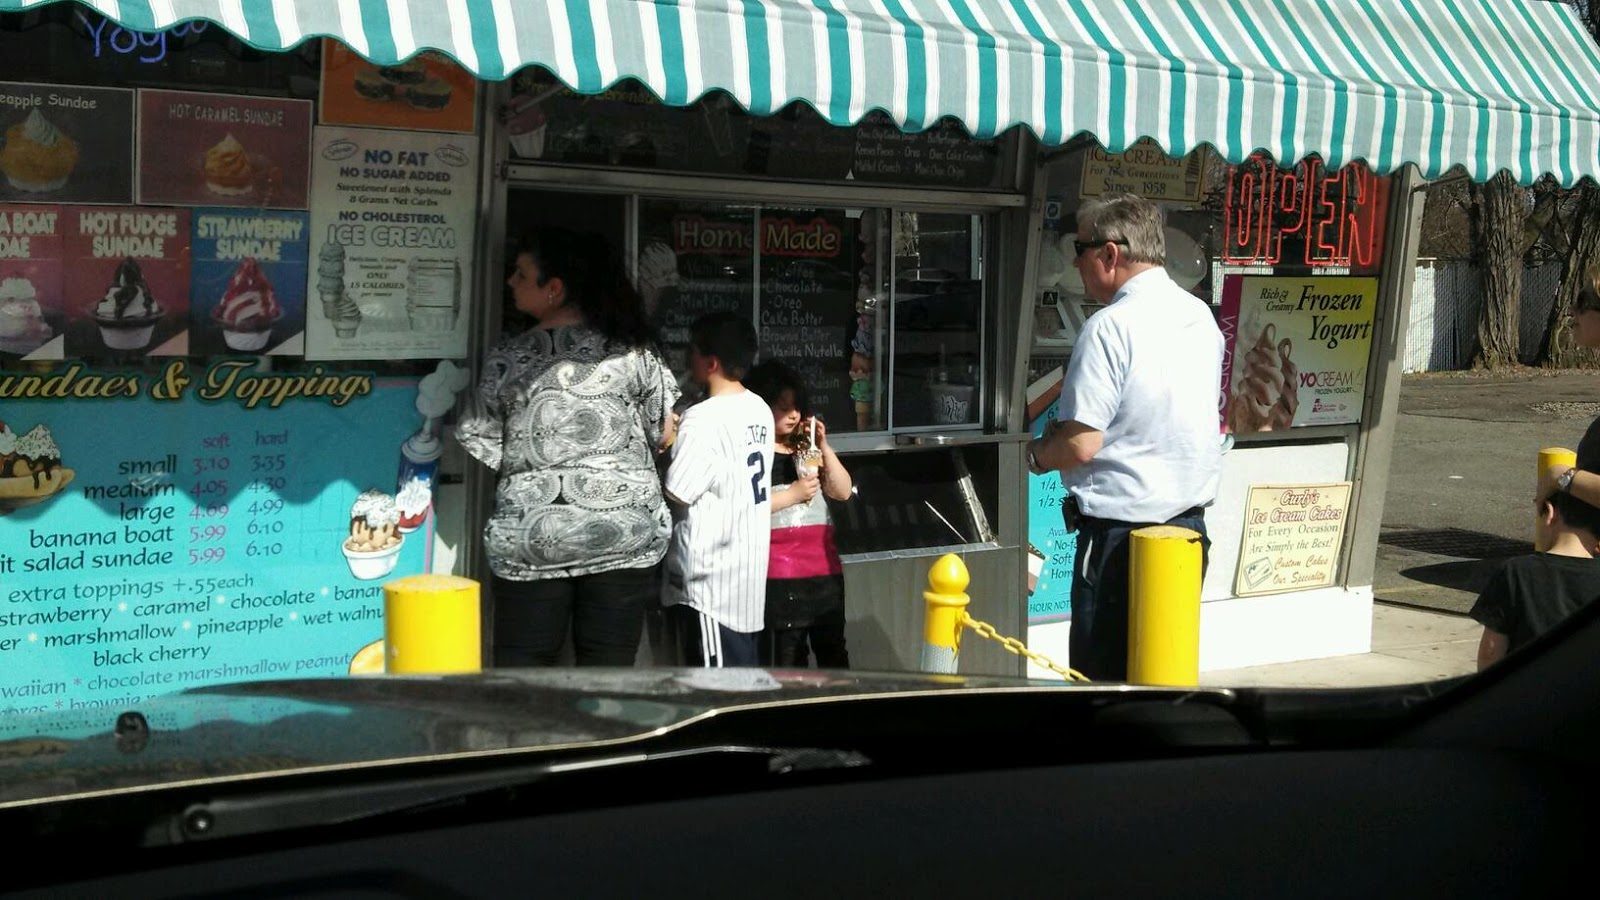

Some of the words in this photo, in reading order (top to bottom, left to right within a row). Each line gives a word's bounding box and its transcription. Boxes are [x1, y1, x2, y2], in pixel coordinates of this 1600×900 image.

[48, 94, 97, 109] Sundae
[169, 104, 191, 119] HOT
[194, 105, 242, 124] CARAMEL
[244, 110, 283, 126] SUNDAE
[364, 149, 393, 164] NO
[397, 151, 429, 166] FAT
[904, 146, 921, 158] Oreo
[339, 167, 360, 178] NO
[363, 168, 406, 180] SUGAR
[409, 171, 451, 182] ADDED
[1090, 165, 1106, 176] For
[1127, 167, 1181, 181] Generations
[336, 183, 388, 193] Sweetened
[414, 186, 452, 196] Splenda
[1103, 177, 1134, 193] Since
[1142, 181, 1167, 196] 1958
[358, 195, 390, 205] Grams
[392, 196, 408, 205] Net
[410, 197, 438, 206] Carbs
[339, 211, 359, 221] NO
[361, 212, 447, 225] CHOLESTEROL
[1221, 155, 1377, 265] OPEN
[13, 212, 58, 234] BOAT
[80, 213, 114, 235] HOT
[118, 213, 178, 235] FUDGE
[198, 217, 304, 241] STRAWBERRY
[327, 224, 366, 247] ICE
[371, 225, 456, 249] CREAM
[679, 220, 752, 249] Home
[766, 224, 836, 250] Made
[93, 237, 165, 258] SUNDAE
[216, 239, 282, 261] SUNDAE
[366, 272, 390, 280] ONLY
[362, 282, 405, 290] CALORIES
[765, 278, 824, 294] Chocolate
[1259, 287, 1280, 302] Rich
[774, 294, 802, 309] Oreo
[1295, 285, 1364, 311] Frozen
[1266, 301, 1295, 315] Creamy
[761, 309, 788, 325] Cake
[791, 309, 824, 326] Batter
[1308, 315, 1371, 350] Yogurt
[771, 343, 802, 358] Vanilla
[804, 342, 844, 358] Nutella
[0, 366, 139, 398] undaes
[152, 360, 190, 400] &
[200, 361, 373, 408] Toppings
[1299, 370, 1353, 388] YOCREAM
[202, 433, 232, 448] soft
[254, 430, 289, 447] hard
[118, 454, 178, 475] small
[192, 456, 231, 474] 3.10
[249, 454, 286, 473] 3.35
[747, 451, 767, 505] 2
[1040, 477, 1056, 492] 1/4
[83, 479, 176, 499] medium
[189, 480, 229, 497] 4.05
[247, 476, 287, 493] 4.30
[1038, 494, 1055, 509] 1/2
[1280, 489, 1320, 508] Curly's
[118, 502, 176, 525] large
[188, 500, 230, 519] 4.69
[246, 499, 284, 516] 4.99
[1250, 508, 1268, 525] Ice
[1270, 507, 1307, 523] Cream
[1309, 505, 1342, 521] Cakes
[29, 529, 117, 549] banana
[124, 525, 174, 544] boat
[188, 525, 227, 543] 5.99
[246, 519, 284, 536] 6.10
[1248, 527, 1262, 539] For
[1267, 525, 1292, 538] Every
[1298, 523, 1339, 534] Occasion
[1249, 544, 1262, 554] Are
[1265, 540, 1294, 555] Simply
[1296, 539, 1308, 550] the
[1311, 537, 1334, 549] Best!
[23, 550, 85, 573] salad
[91, 547, 174, 570] sundae
[187, 547, 226, 566] 5.99
[245, 540, 283, 558] 6.10
[1052, 552, 1072, 566] Soft
[1274, 557, 1302, 571] Custom
[1305, 554, 1329, 568] Cakes
[1051, 568, 1074, 580] Hom
[1272, 573, 1286, 585] Our
[8, 586, 66, 604] extra
[73, 578, 164, 602] toppings
[0, 606, 112, 627] strawberry
[133, 596, 211, 618] caramel
[230, 590, 315, 610] chocolate
[1030, 602, 1053, 613] HOUR
[1053, 600, 1071, 611] NOT
[44, 623, 177, 648] marshmallow
[197, 614, 284, 639] pineapple
[303, 611, 333, 626] wet
[93, 647, 144, 667] black
[149, 645, 211, 667] cherry
[1, 679, 67, 698] waiian
[87, 668, 174, 692] chocolate
[178, 658, 291, 683] marshmallow
[295, 652, 351, 674] peanut
